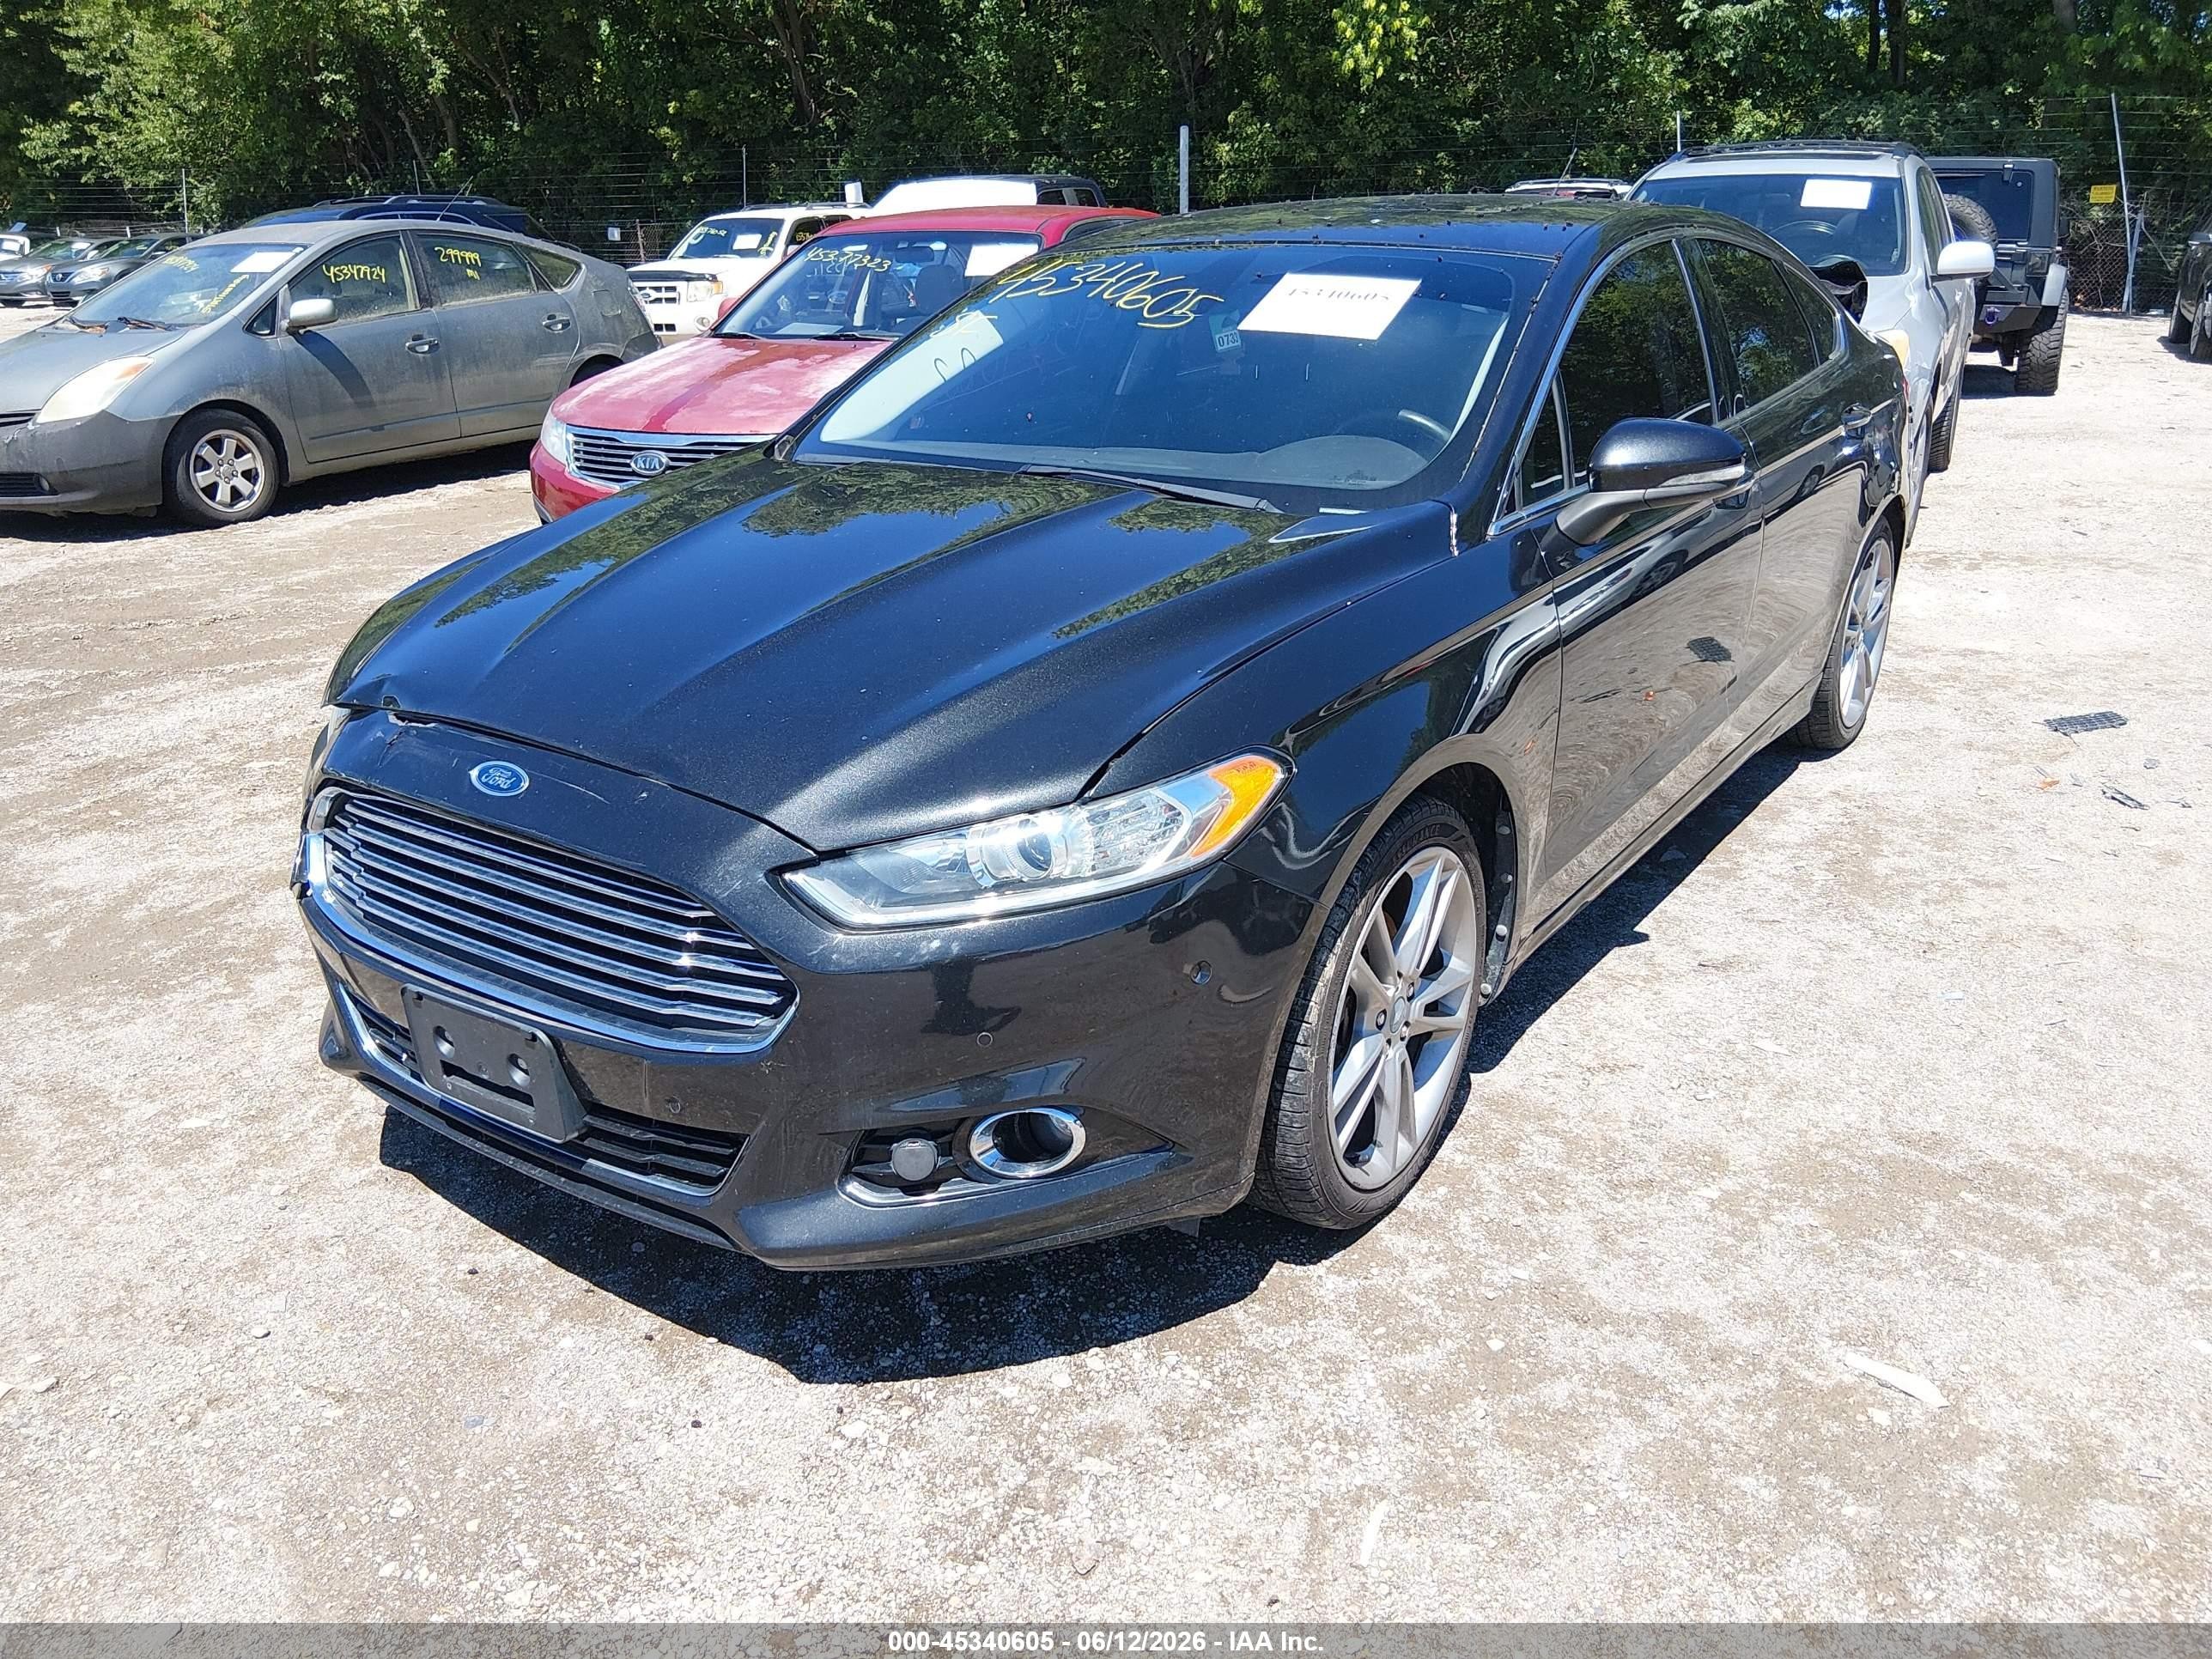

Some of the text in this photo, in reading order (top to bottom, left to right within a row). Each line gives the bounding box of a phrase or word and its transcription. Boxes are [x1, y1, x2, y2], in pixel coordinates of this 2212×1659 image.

[805, 246, 892, 272] 45377323
[322, 264, 386, 283] 45347924
[988, 258, 1225, 328] 45340605
[1218, 331, 1239, 348] 0733
